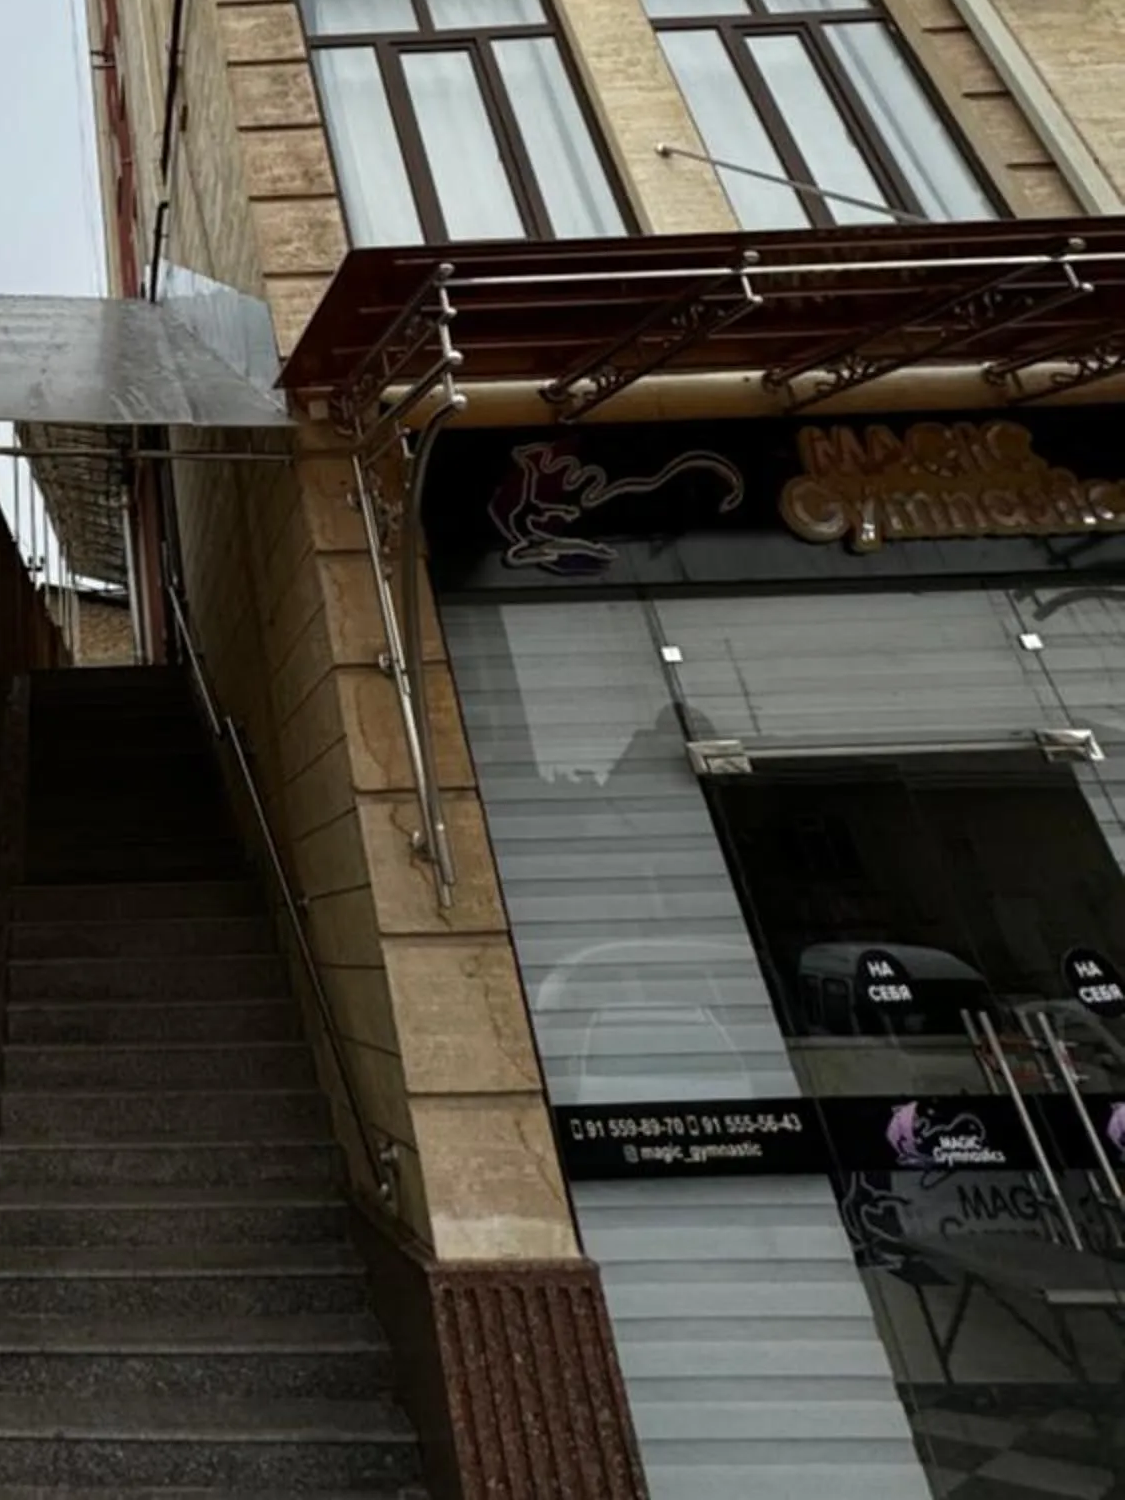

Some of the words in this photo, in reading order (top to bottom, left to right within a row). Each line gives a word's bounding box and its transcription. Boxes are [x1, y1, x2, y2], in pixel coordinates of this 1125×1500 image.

[798, 420, 1032, 477] MAGIC
[780, 468, 1125, 552] Gymnastic
[867, 960, 895, 978] НА
[1075, 960, 1103, 978] НА
[868, 984, 913, 1002] СЕБЯ
[1078, 983, 1124, 1003] СЕБЯ
[584, 1118, 606, 1139] 91
[701, 1114, 722, 1135] 91
[939, 1135, 982, 1149] MAGIC
[957, 1184, 1043, 1221] MAG
